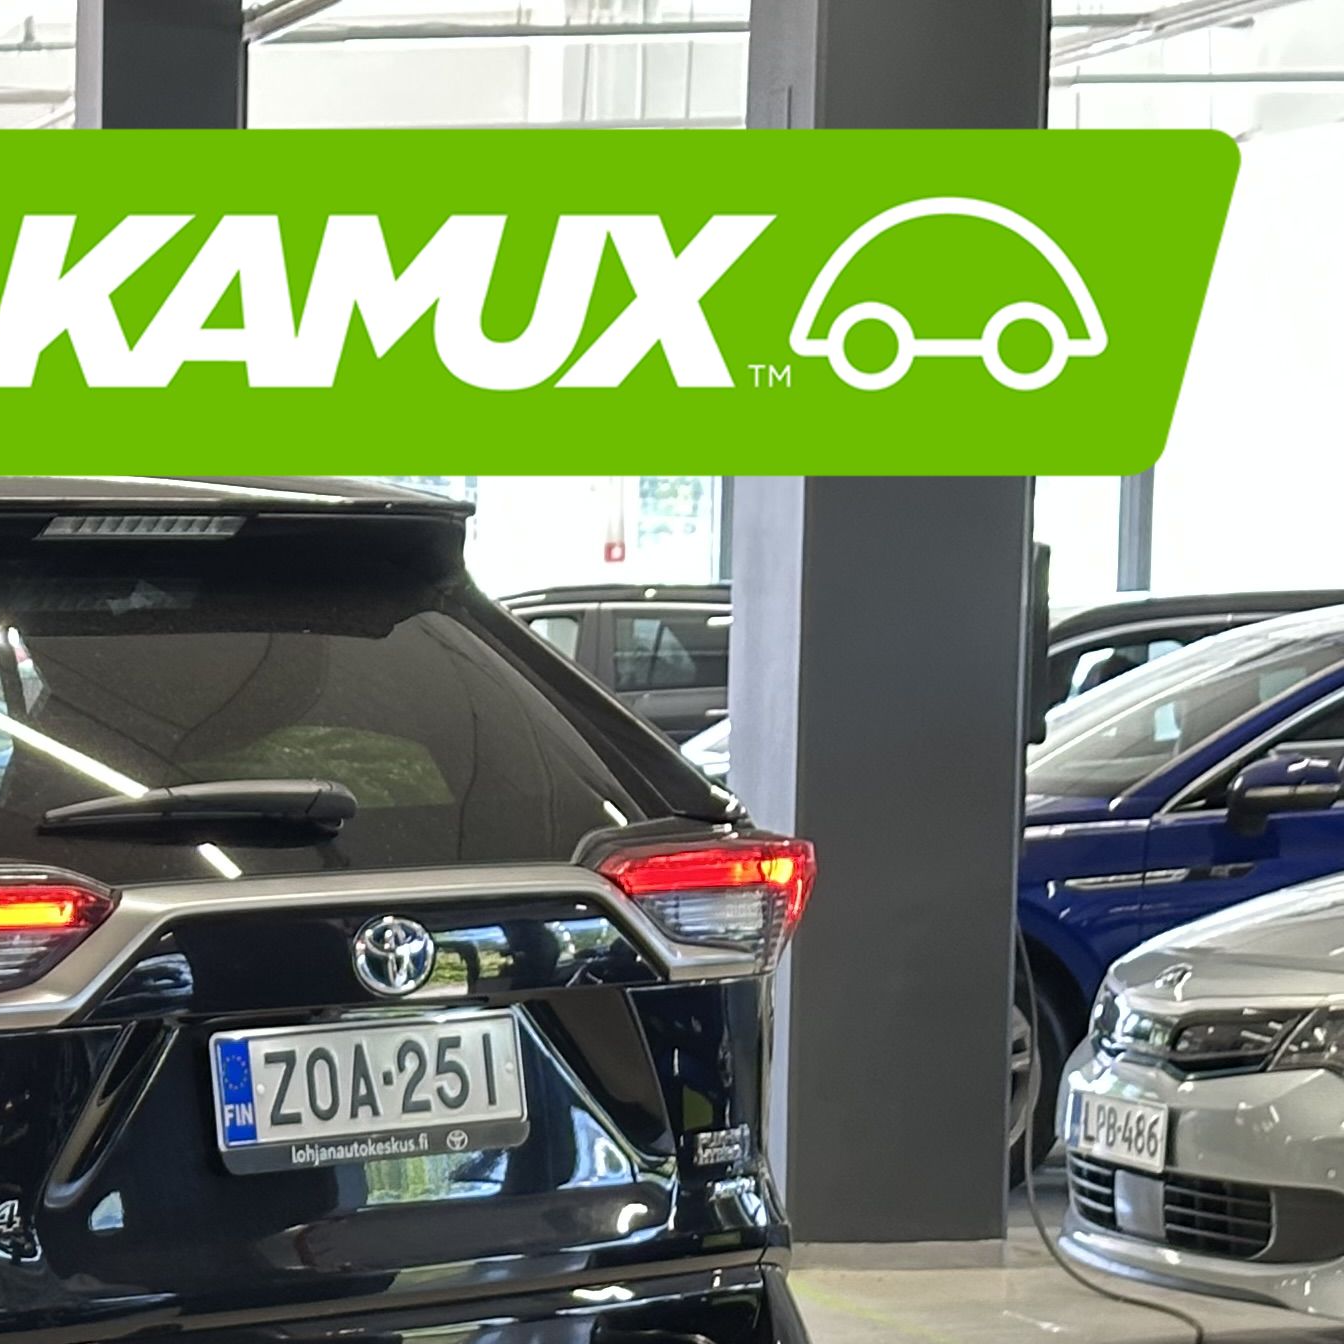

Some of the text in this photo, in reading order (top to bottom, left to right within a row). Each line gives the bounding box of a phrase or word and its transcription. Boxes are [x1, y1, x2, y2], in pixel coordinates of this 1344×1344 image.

[263, 1032, 497, 1127] ZOA-251
[224, 1101, 254, 1128] FIN
[1083, 1101, 1161, 1159] LPB-486
[292, 1133, 429, 1166] lohjanautokeskus.fi
